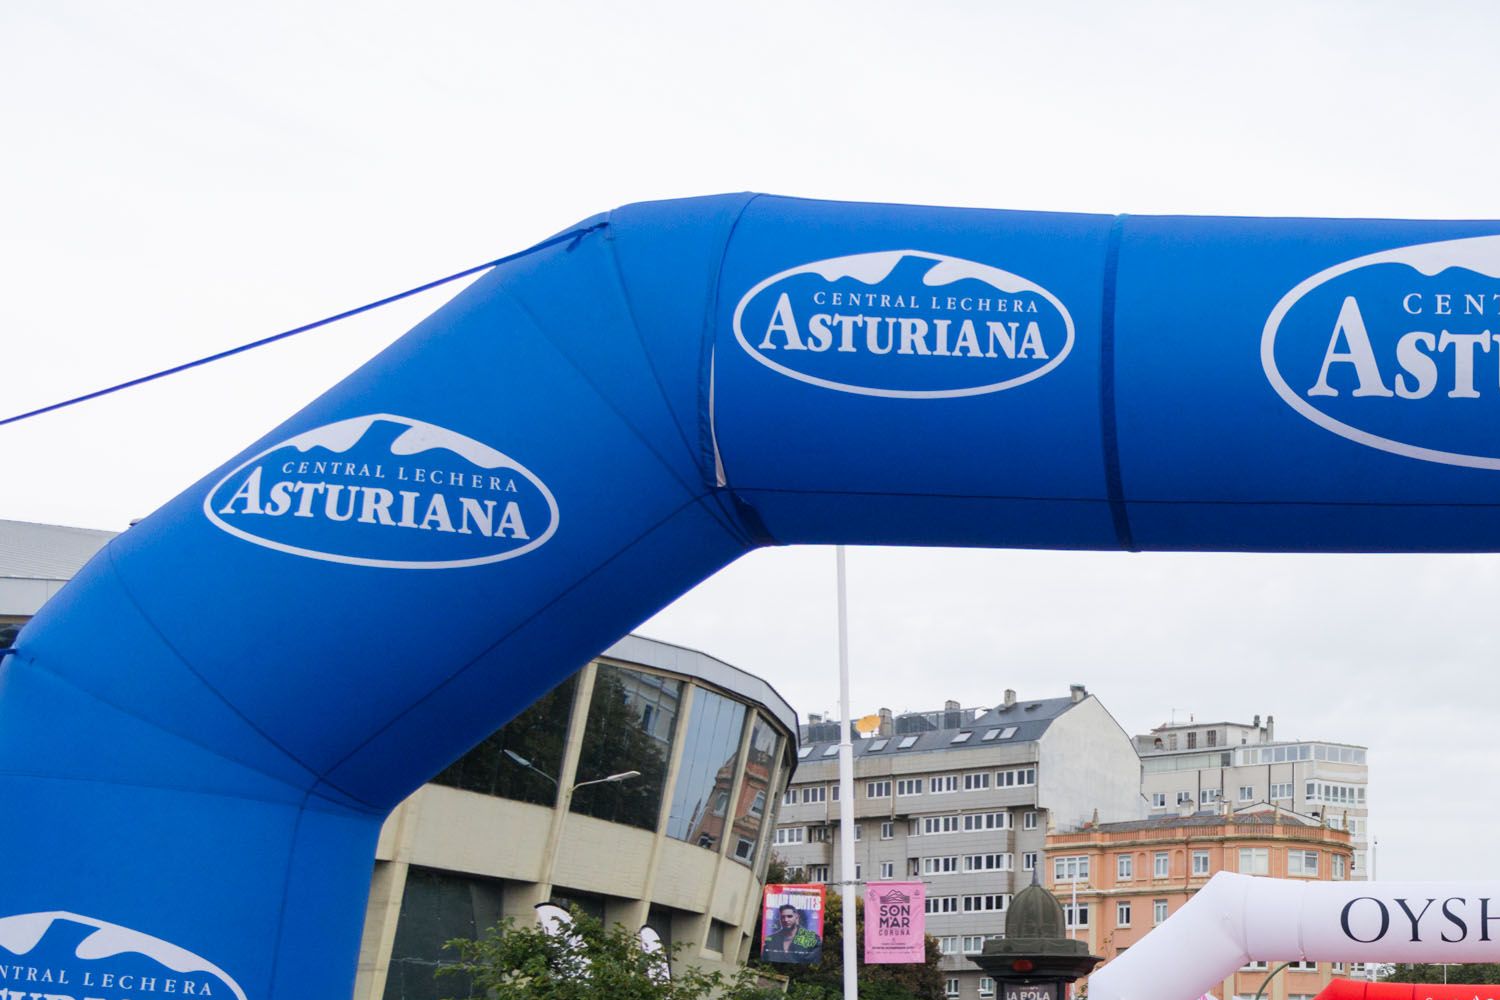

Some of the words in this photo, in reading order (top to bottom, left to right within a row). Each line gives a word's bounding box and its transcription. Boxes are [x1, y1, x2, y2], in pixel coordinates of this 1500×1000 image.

[813, 290, 920, 309] CENTRAL
[931, 296, 1039, 313] LECHERA
[758, 292, 1050, 361] ASTURIANA
[281, 459, 386, 482] CENTRAL
[397, 464, 520, 494] LECHERA
[218, 465, 530, 541] ASTURIANA
[879, 904, 911, 917] SON
[83, 972, 214, 997] LECHERA
[1006, 991, 1018, 1000] LA
[1020, 991, 1051, 1000] BOLA
